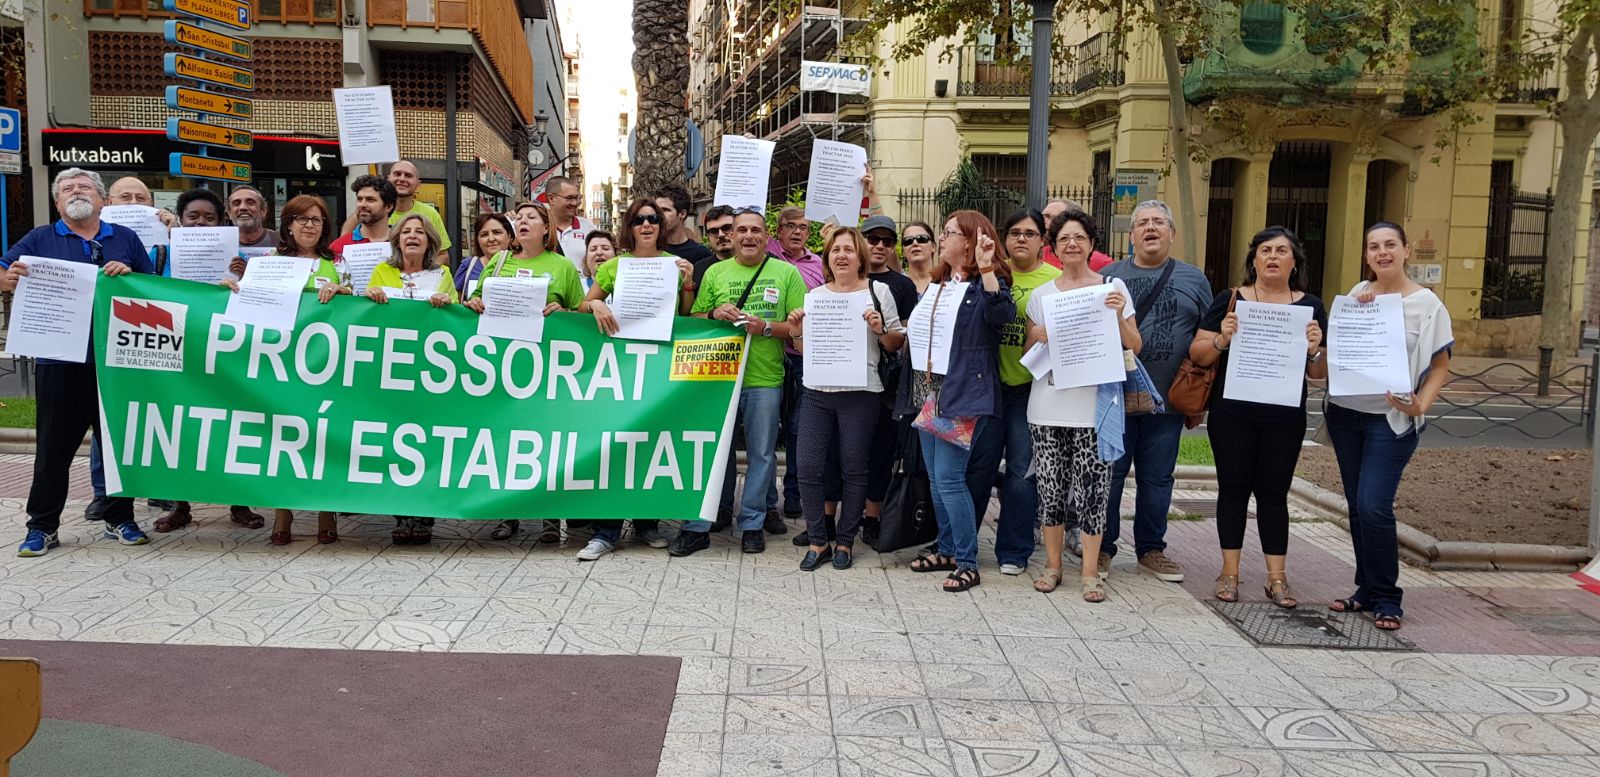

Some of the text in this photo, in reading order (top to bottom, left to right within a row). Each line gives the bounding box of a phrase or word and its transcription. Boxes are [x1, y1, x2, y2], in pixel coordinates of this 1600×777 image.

[192, 2, 234, 20] PLAZAS LIBRES
[187, 30, 200, 40] San
[187, 63, 212, 76] Alfonso
[214, 68, 233, 80] Sabio
[180, 126, 216, 140] Maisonnave
[50, 146, 144, 164] kutxabank
[306, 145, 321, 170] k
[232, 166, 248, 178] 153
[116, 330, 183, 351] STEPV
[676, 342, 741, 354] COORDINADORA
[116, 348, 182, 361] INTERSINDICAL
[204, 312, 658, 401] PROFESSORAT
[675, 352, 741, 362] DE PROFESSORAT
[126, 357, 182, 369] VALENCIANA
[122, 400, 716, 491] INTERÍ ESTABILITAT
